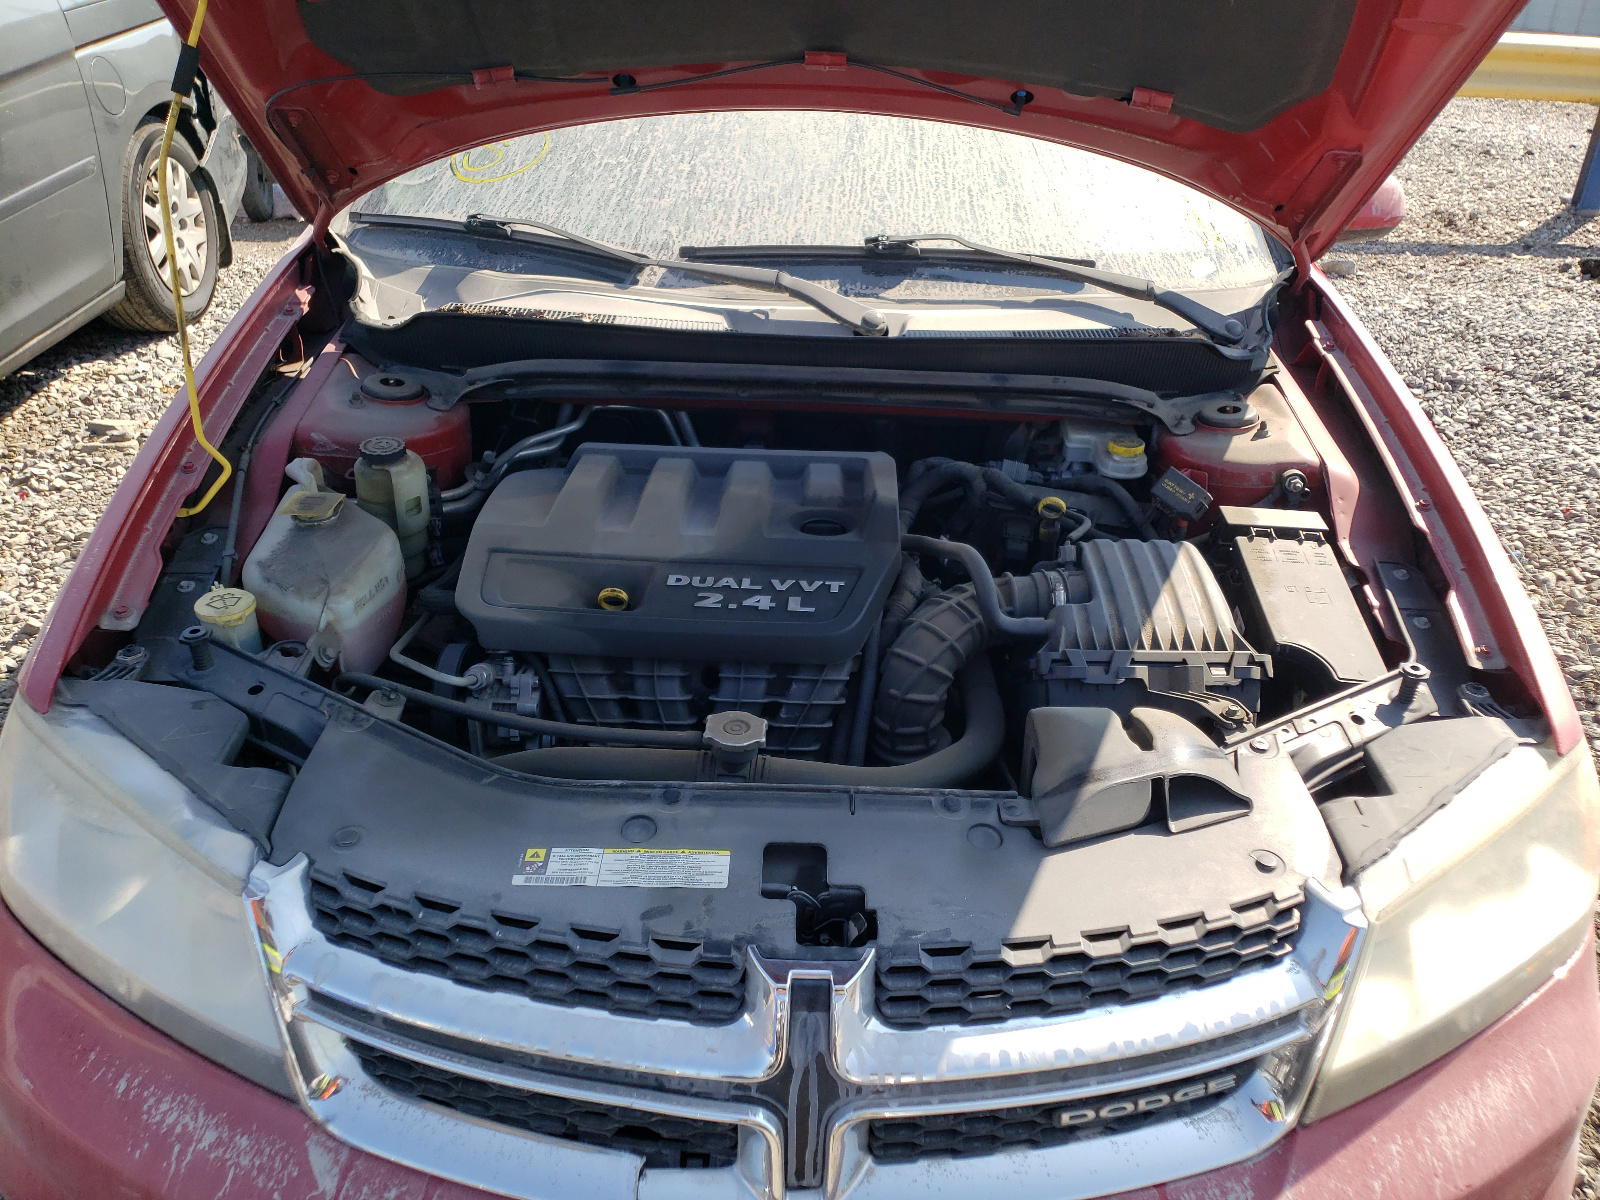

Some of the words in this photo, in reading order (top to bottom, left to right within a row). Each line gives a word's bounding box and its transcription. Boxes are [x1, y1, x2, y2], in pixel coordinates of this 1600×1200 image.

[666, 574, 763, 590] DUAL
[770, 578, 846, 593] VVT
[1060, 1073, 1237, 1127] DODGE
